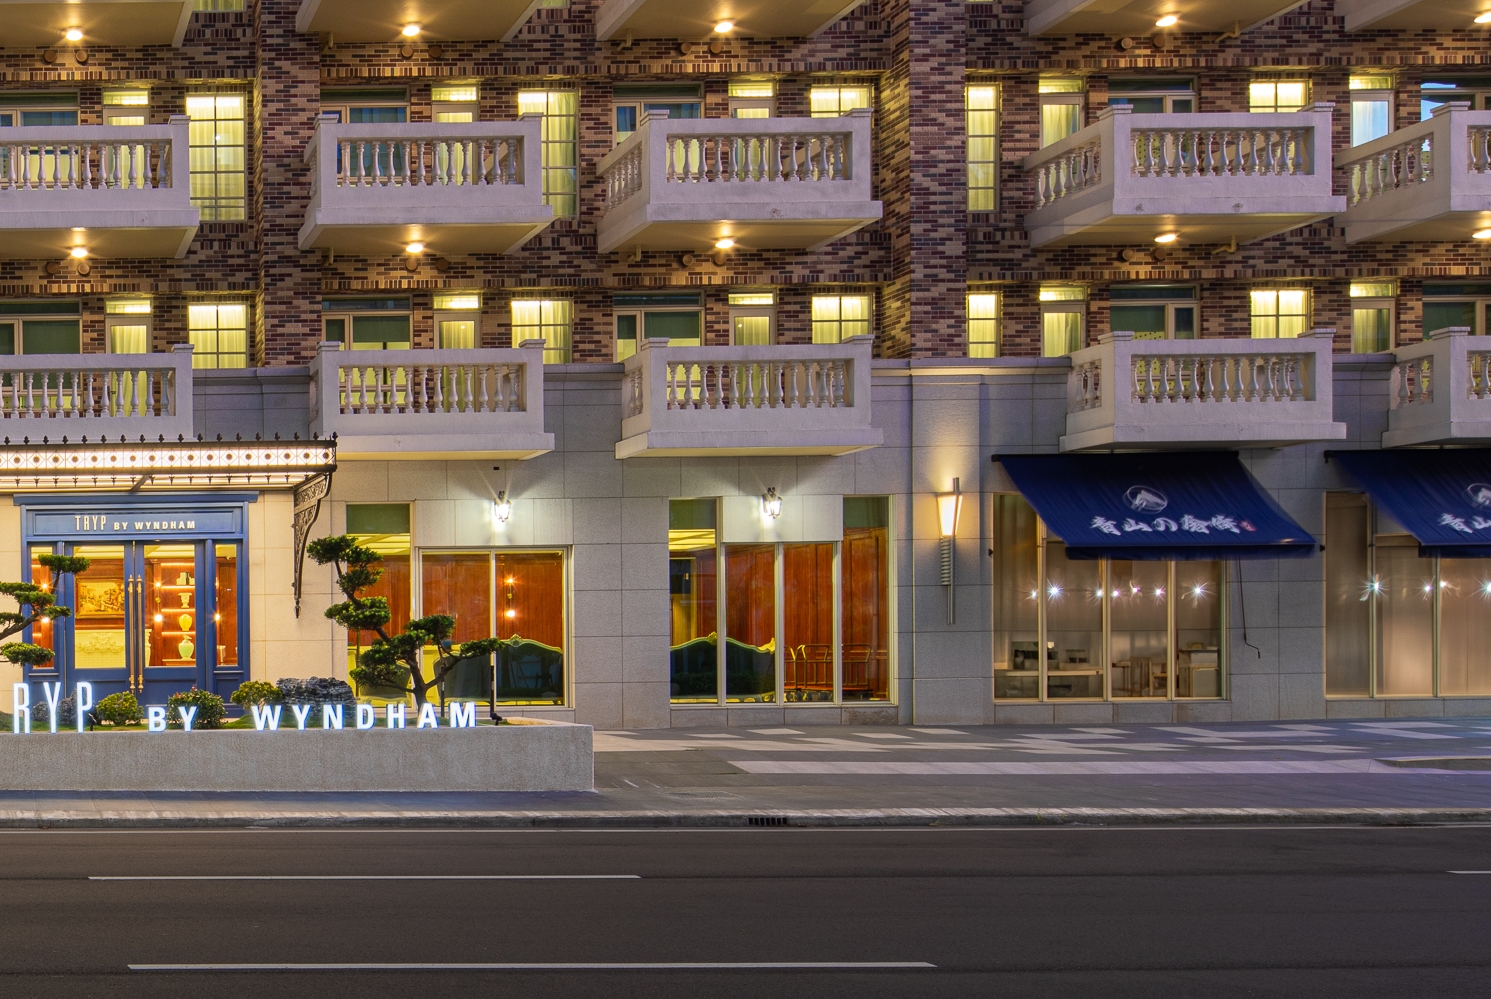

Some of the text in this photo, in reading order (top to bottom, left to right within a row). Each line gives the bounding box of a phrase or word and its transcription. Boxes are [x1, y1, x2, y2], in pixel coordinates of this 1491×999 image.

[74, 515, 196, 531] TRYP BY WYNDHAM
[148, 706, 198, 732] BY
[250, 702, 478, 731] WYNDHAM
